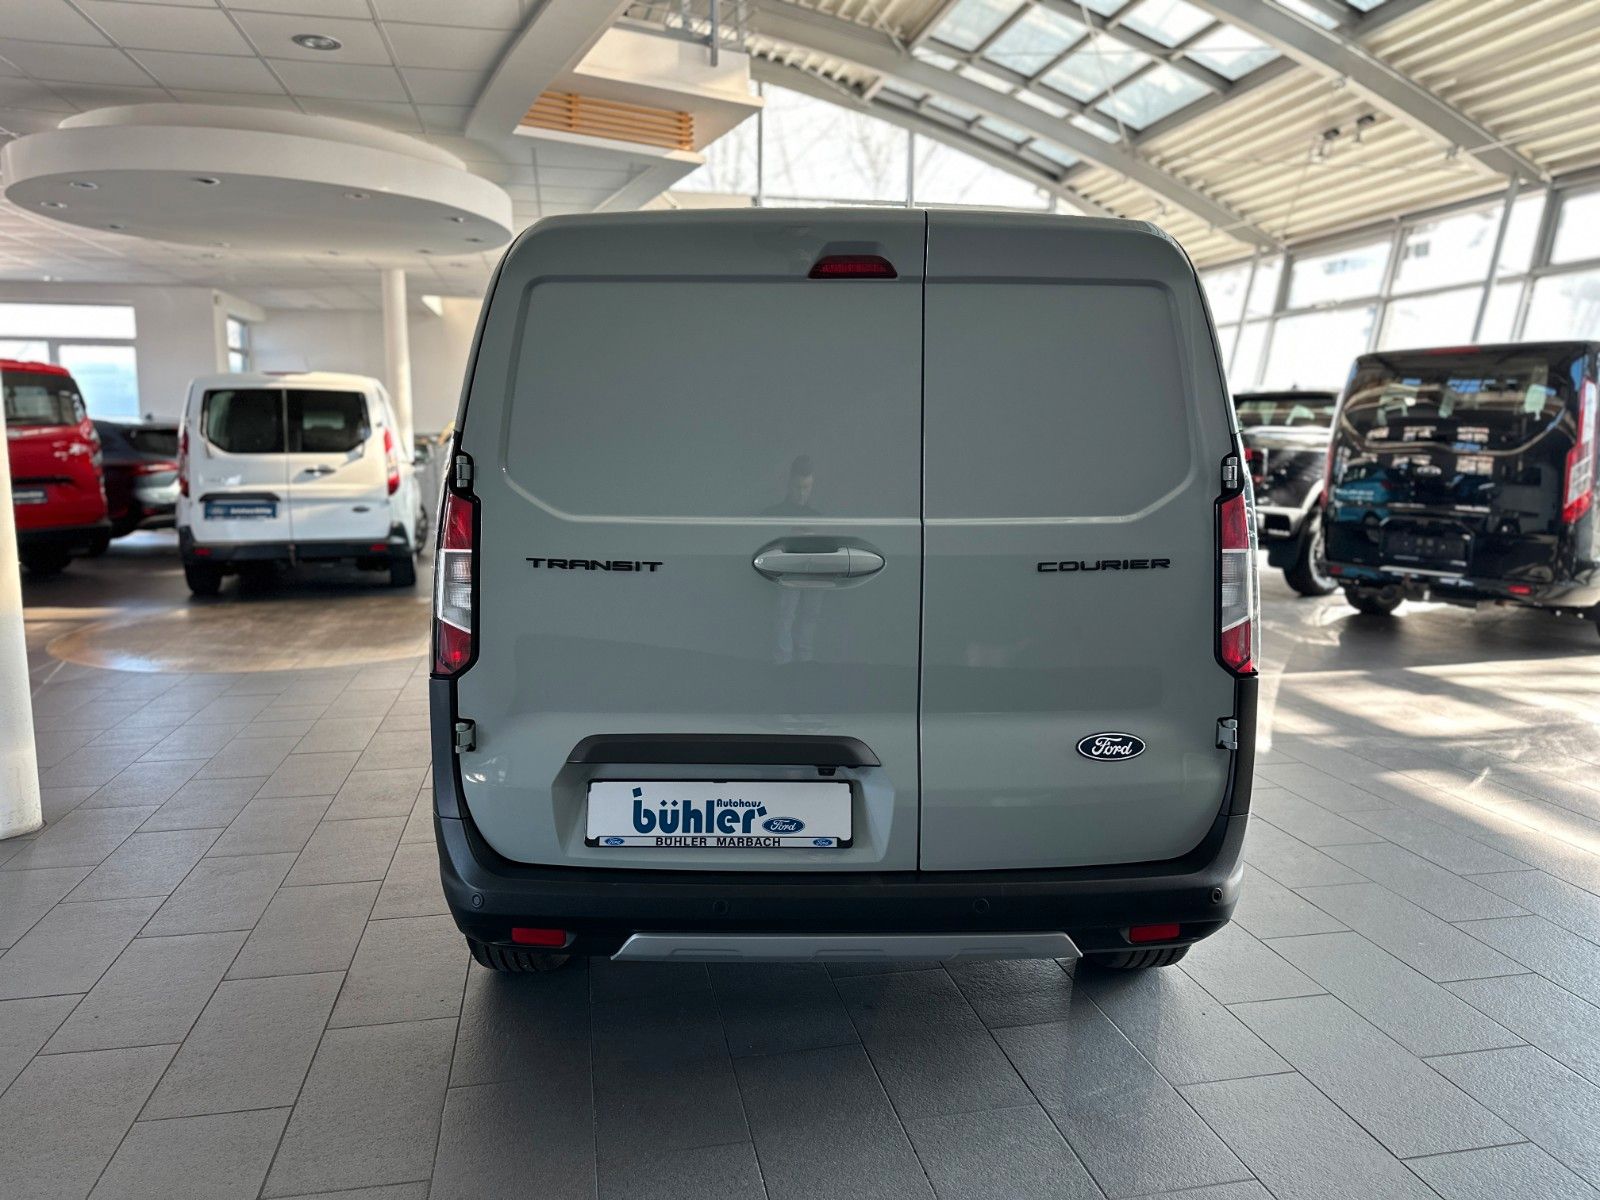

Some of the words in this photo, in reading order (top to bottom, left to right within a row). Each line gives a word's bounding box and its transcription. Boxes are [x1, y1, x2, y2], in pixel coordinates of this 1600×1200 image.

[526, 558, 663, 571] TRANSIT
[1037, 558, 1170, 572] COURIER
[1092, 736, 1133, 756] Ford
[716, 798, 762, 808] Autohaus
[632, 787, 767, 834] bühler
[655, 836, 707, 847] BÜHLER
[716, 837, 782, 847] MARBACH
